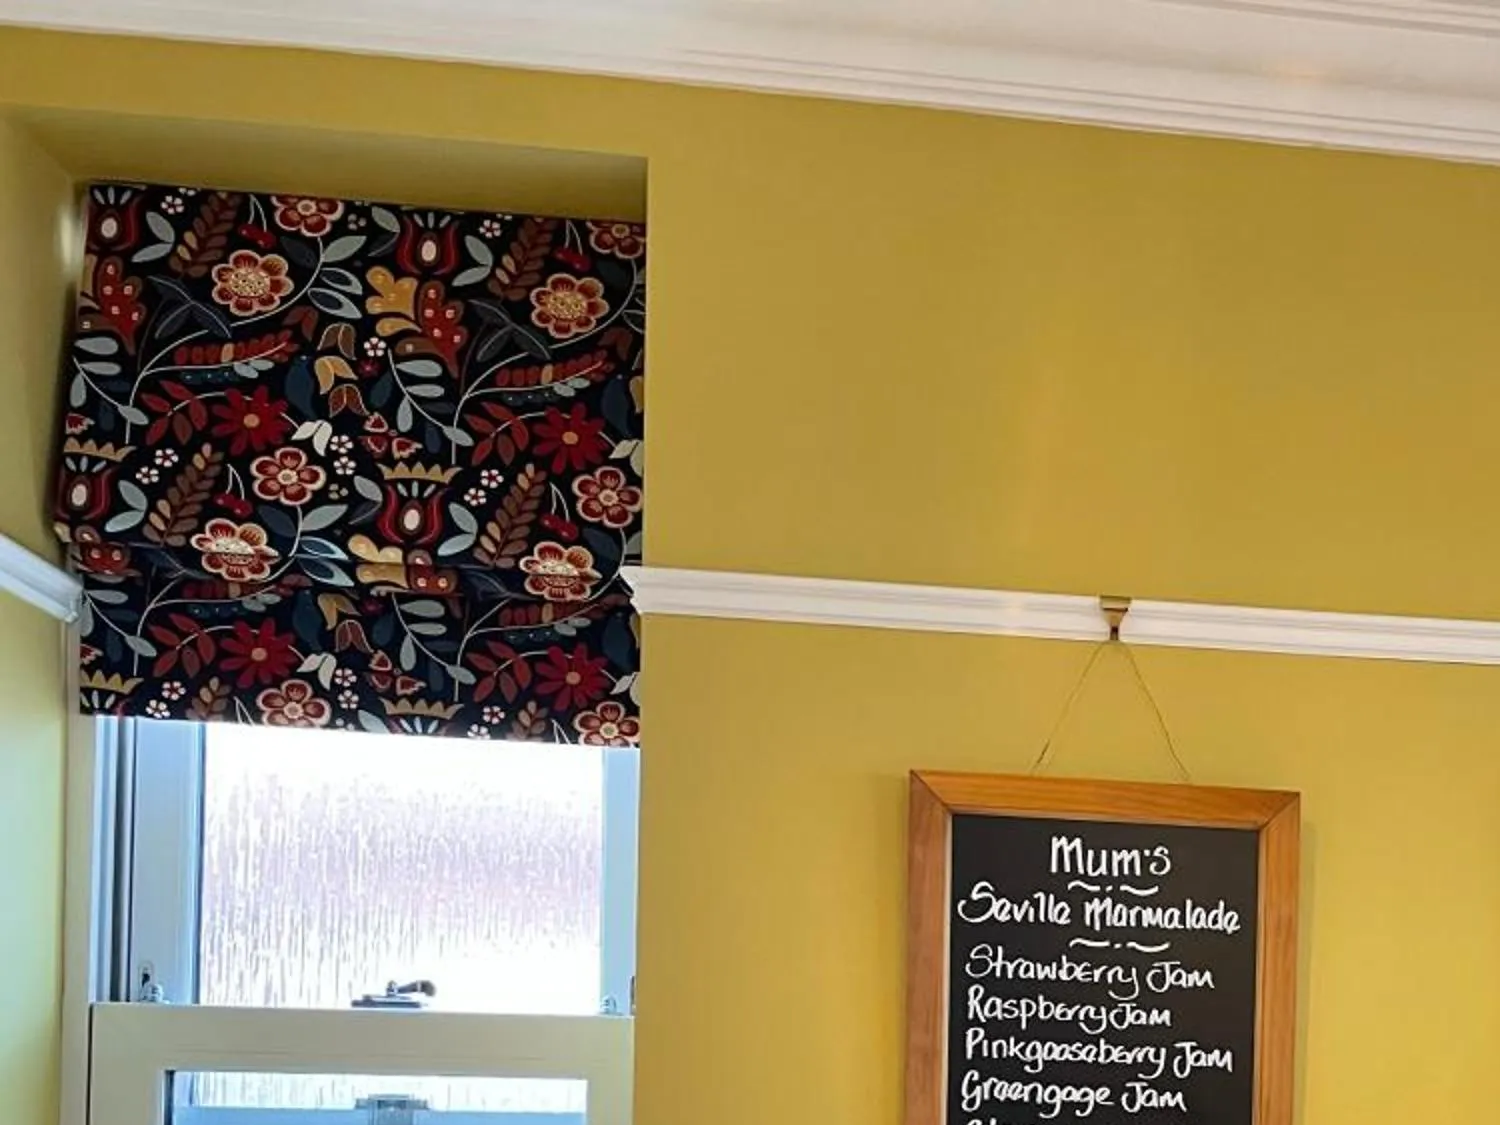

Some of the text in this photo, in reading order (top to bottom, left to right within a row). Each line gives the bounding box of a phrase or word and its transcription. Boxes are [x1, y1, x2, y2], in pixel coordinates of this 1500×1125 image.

[1051, 835, 1171, 876] Mum's
[957, 881, 1241, 934] Seville Marmalade
[965, 944, 1215, 1000] Strawberry Jam
[967, 984, 1172, 1035] Raspberry Jam
[1173, 1041, 1233, 1078] Jam
[961, 1070, 1187, 1118] Greengage Jam
